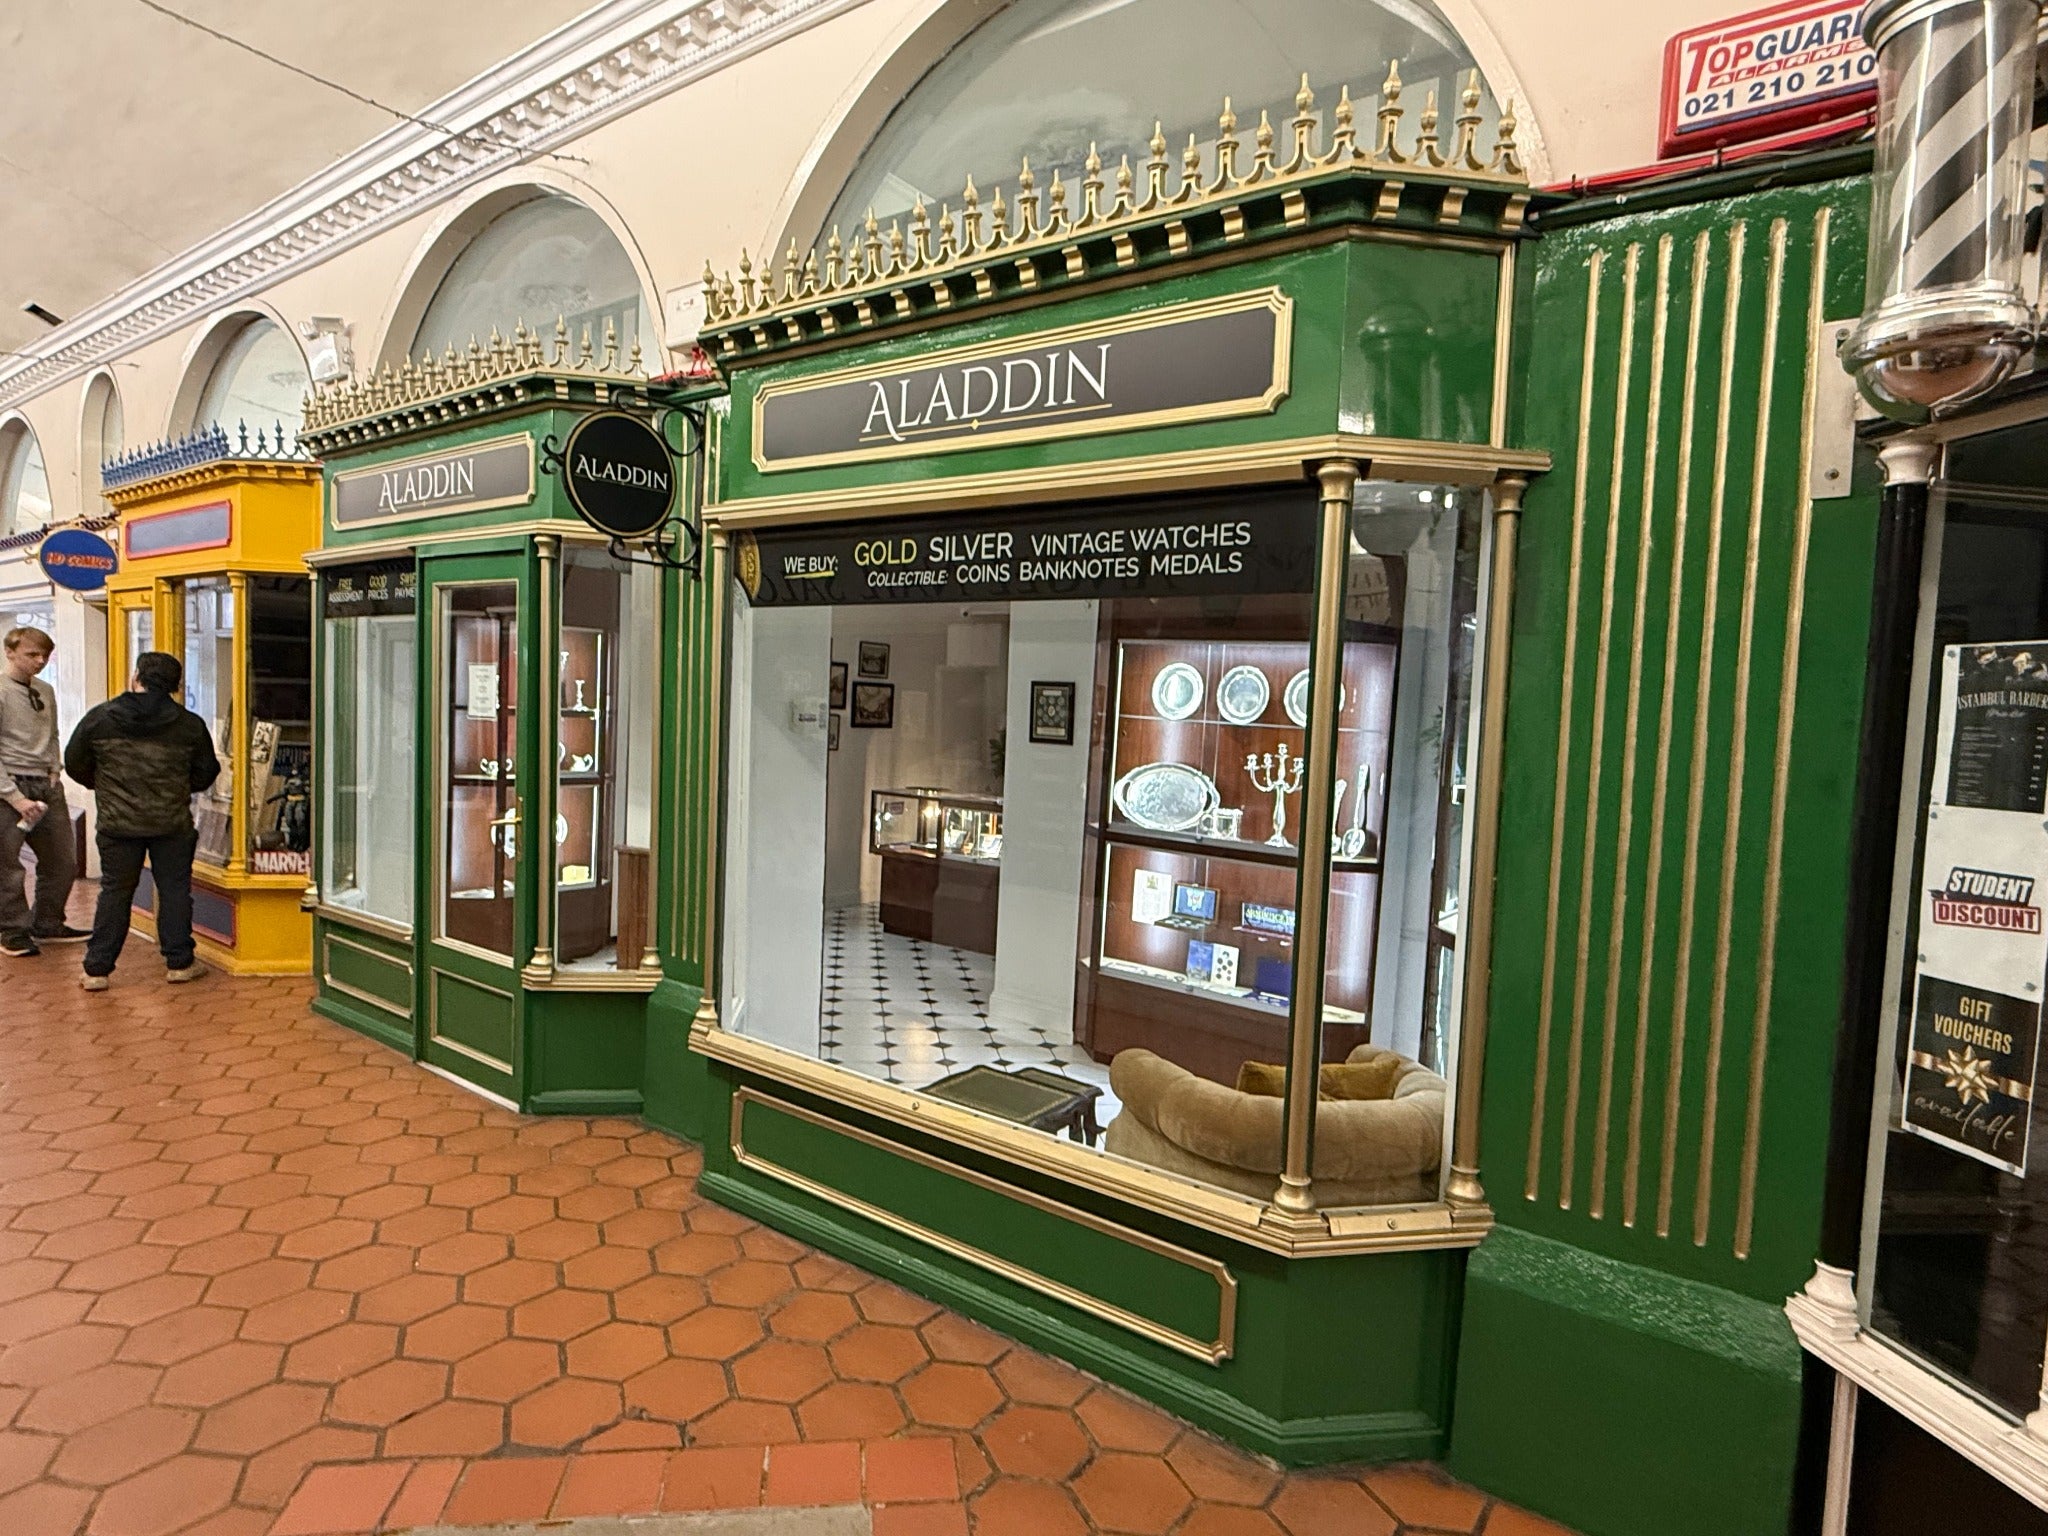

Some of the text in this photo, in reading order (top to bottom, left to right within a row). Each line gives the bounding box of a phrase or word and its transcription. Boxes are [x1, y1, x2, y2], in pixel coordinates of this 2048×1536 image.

[1684, 88, 1735, 117] 021
[1748, 72, 1805, 103] 210
[861, 344, 1111, 442] ALADDIN
[379, 458, 474, 513] ALADDIN
[576, 455, 668, 491] ALADDIN
[854, 522, 1251, 567] GOLD SILVER VINTAGE WATCHES
[784, 555, 839, 573] WE BUY:
[867, 569, 948, 588] COLLECTIBLE:
[956, 562, 1011, 584] COINS
[1019, 556, 1139, 582] BANKNOTES
[1150, 551, 1243, 577] MEDALS
[254, 851, 310, 873] MARVEL
[1949, 870, 2032, 903] STUDENT
[1938, 903, 2036, 930] DISCOUNT
[1960, 996, 1993, 1023] GIFT
[1934, 1013, 2013, 1055] VOUCHERS
